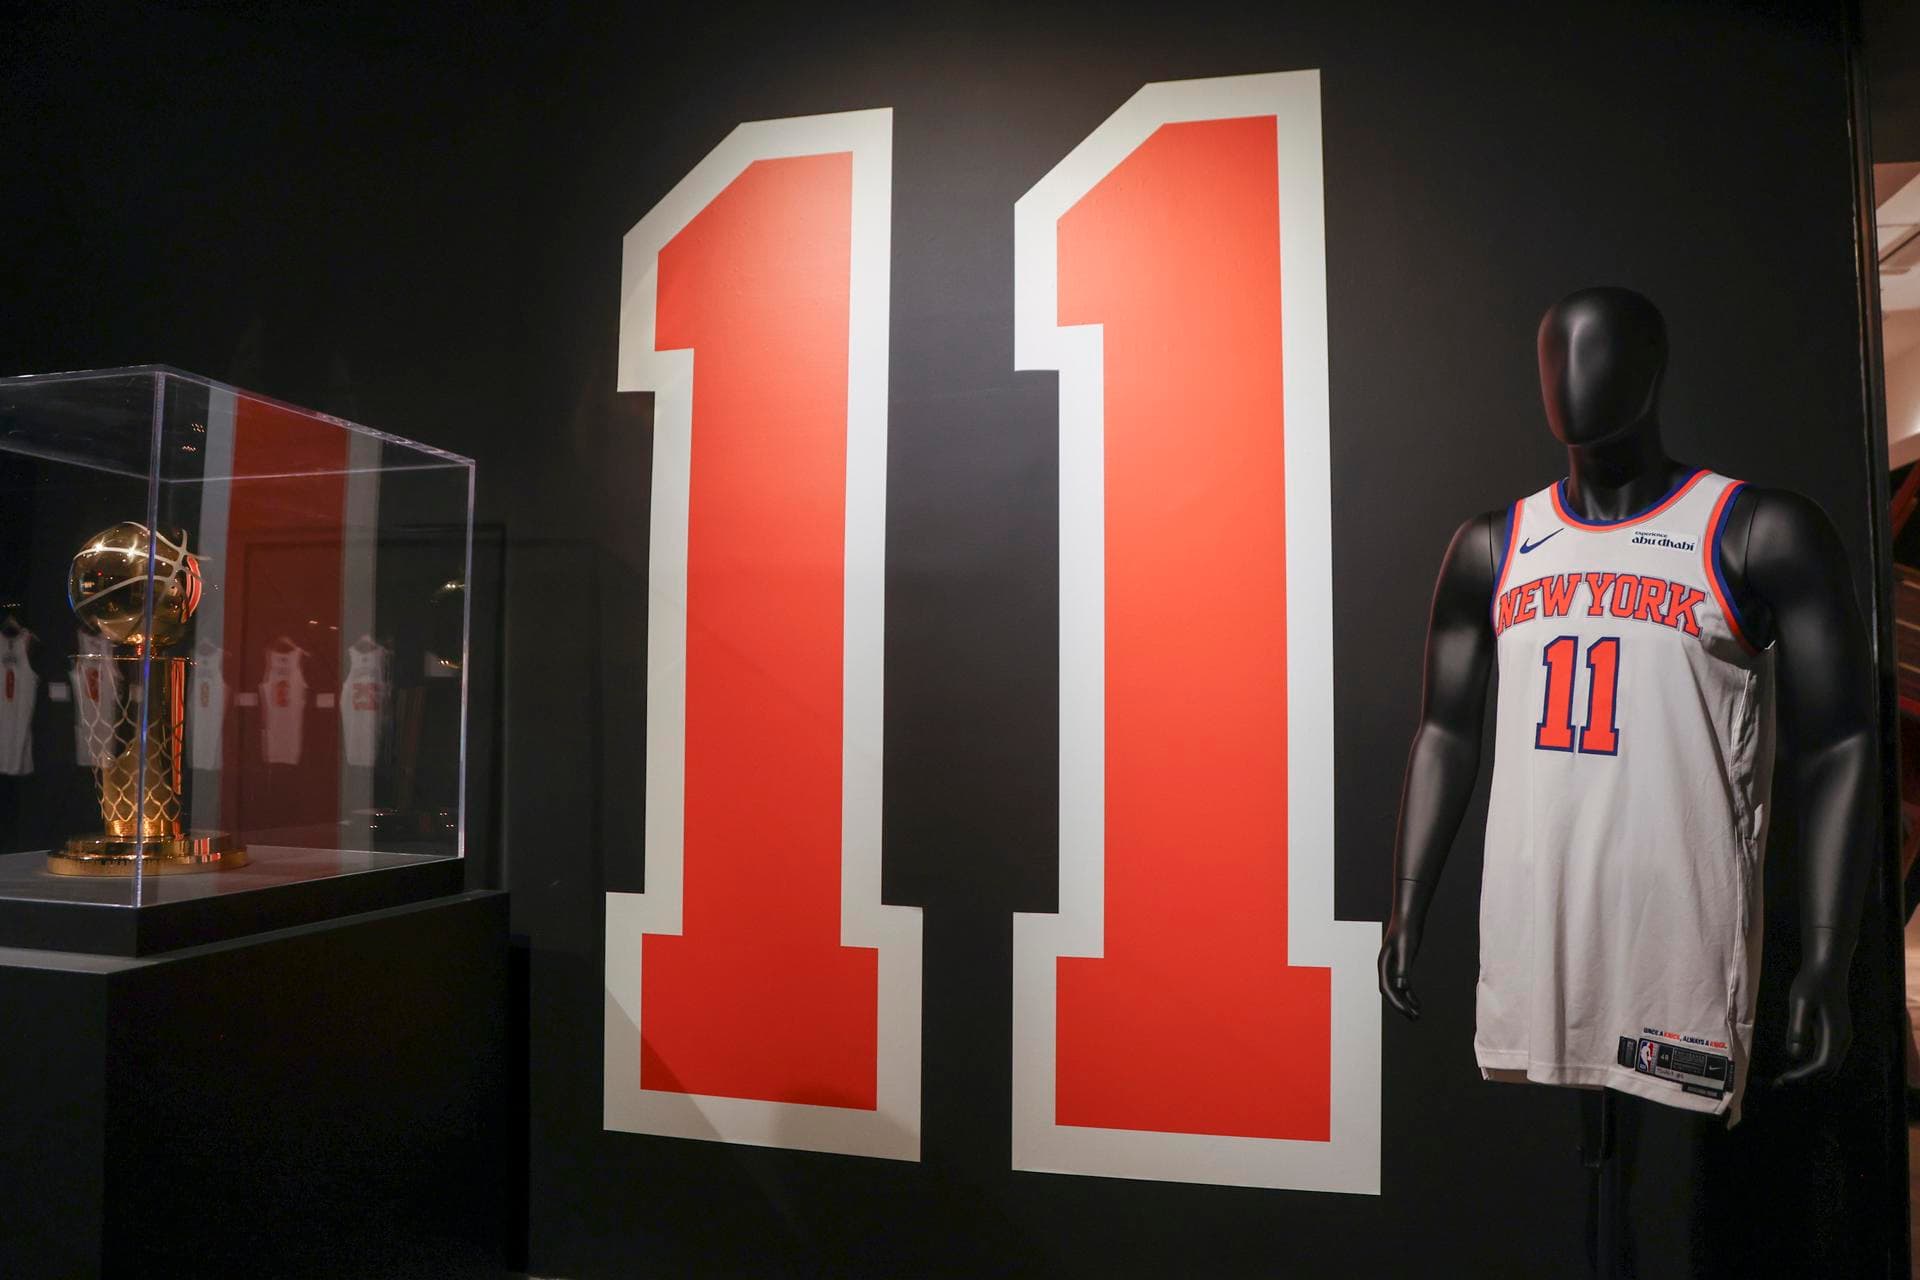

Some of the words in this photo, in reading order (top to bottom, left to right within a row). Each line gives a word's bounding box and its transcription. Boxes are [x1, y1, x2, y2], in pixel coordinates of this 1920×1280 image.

[1632, 536, 1656, 545] abu
[1658, 538, 1695, 551] dhabi
[603, 68, 1382, 1195] 11
[1496, 572, 1583, 637] NEW
[1584, 571, 1709, 641] YORK
[1534, 635, 1621, 756] 11
